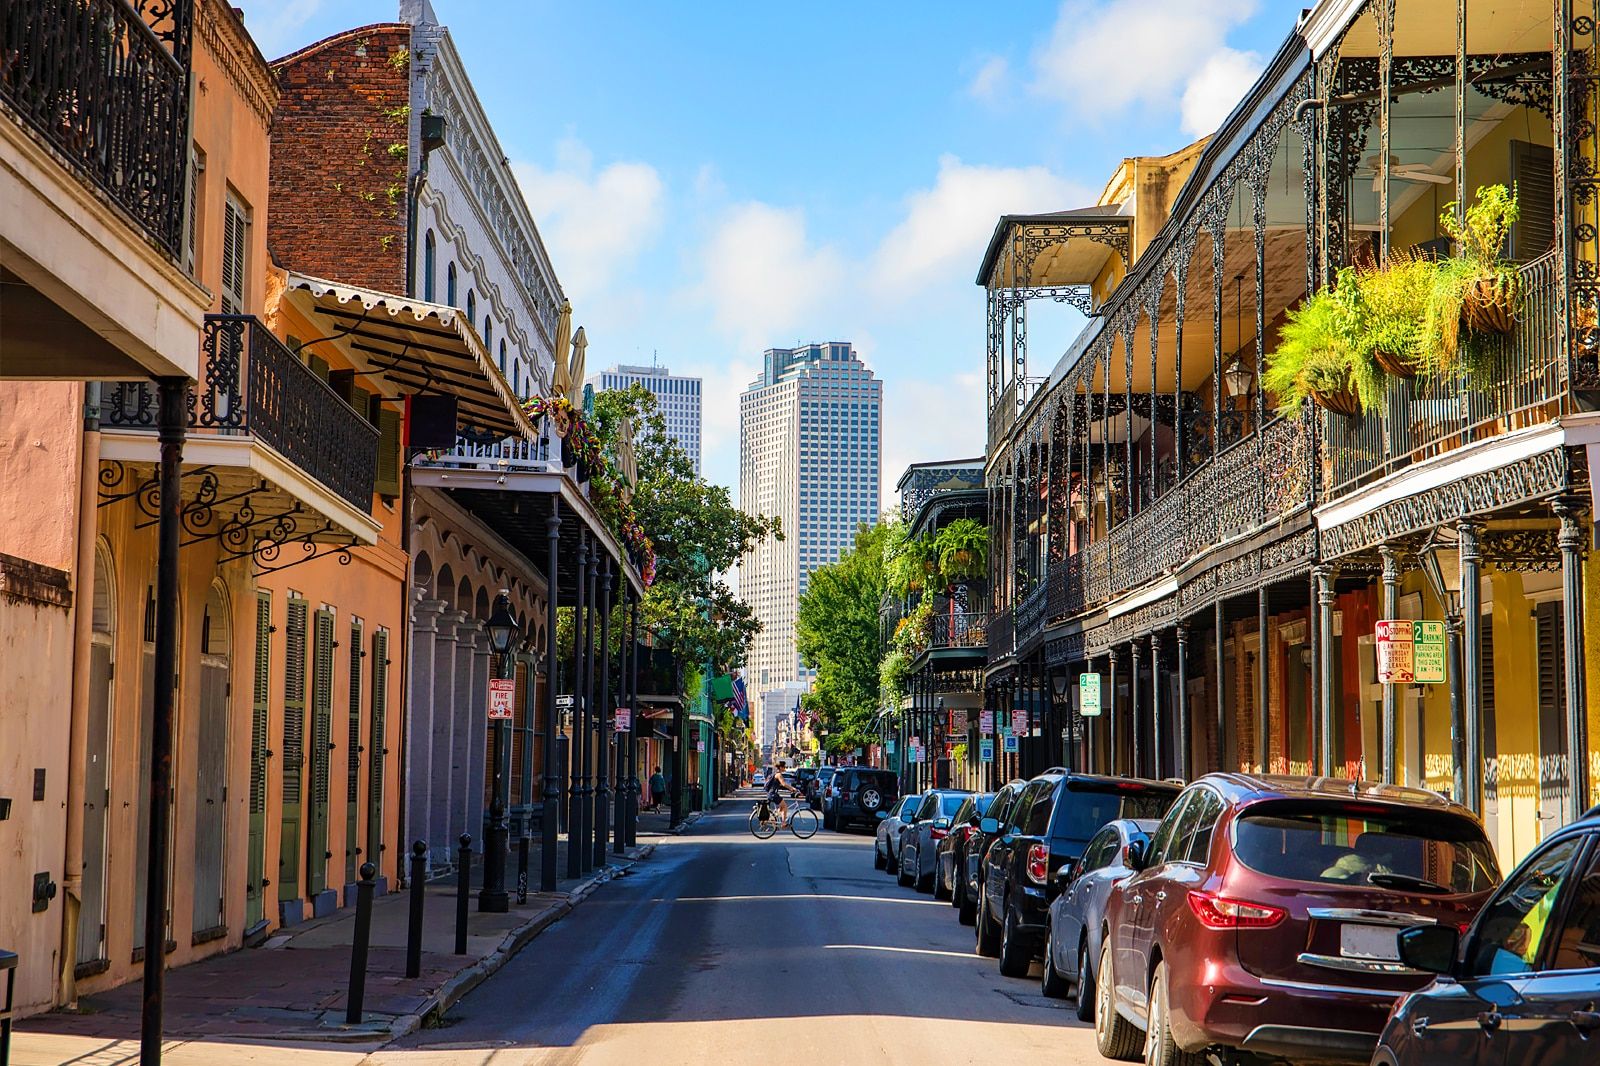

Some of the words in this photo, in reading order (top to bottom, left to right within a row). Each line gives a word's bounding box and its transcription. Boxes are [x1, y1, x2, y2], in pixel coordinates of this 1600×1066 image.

[1377, 626, 1389, 637] NO
[1390, 627, 1412, 636] STOPPING
[1415, 626, 1421, 640] 2
[1423, 634, 1442, 642] PARKING
[1081, 676, 1086, 685] 2
